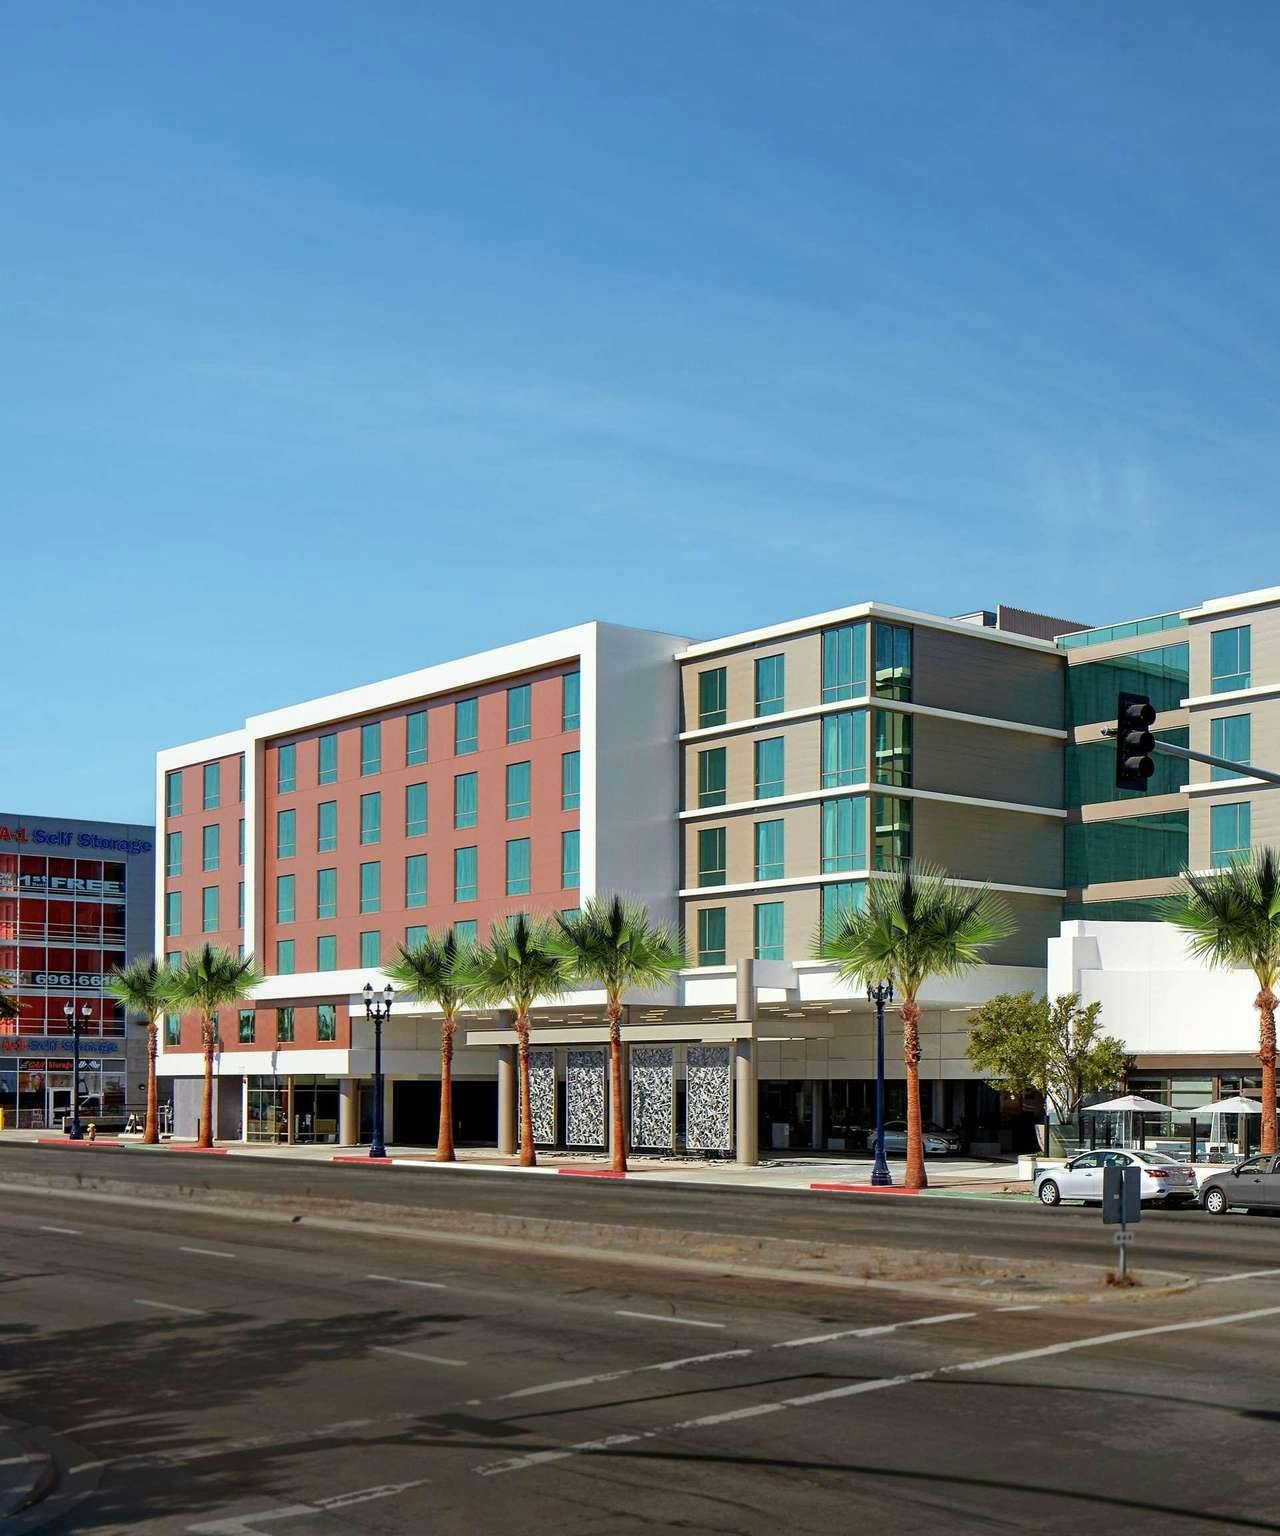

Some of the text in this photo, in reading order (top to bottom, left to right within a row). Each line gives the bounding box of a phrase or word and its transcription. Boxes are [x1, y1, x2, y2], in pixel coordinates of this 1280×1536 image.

[33, 829, 74, 848] Self
[77, 832, 153, 855] Storage
[51, 876, 121, 892] FREE
[29, 1040, 57, 1053] Self
